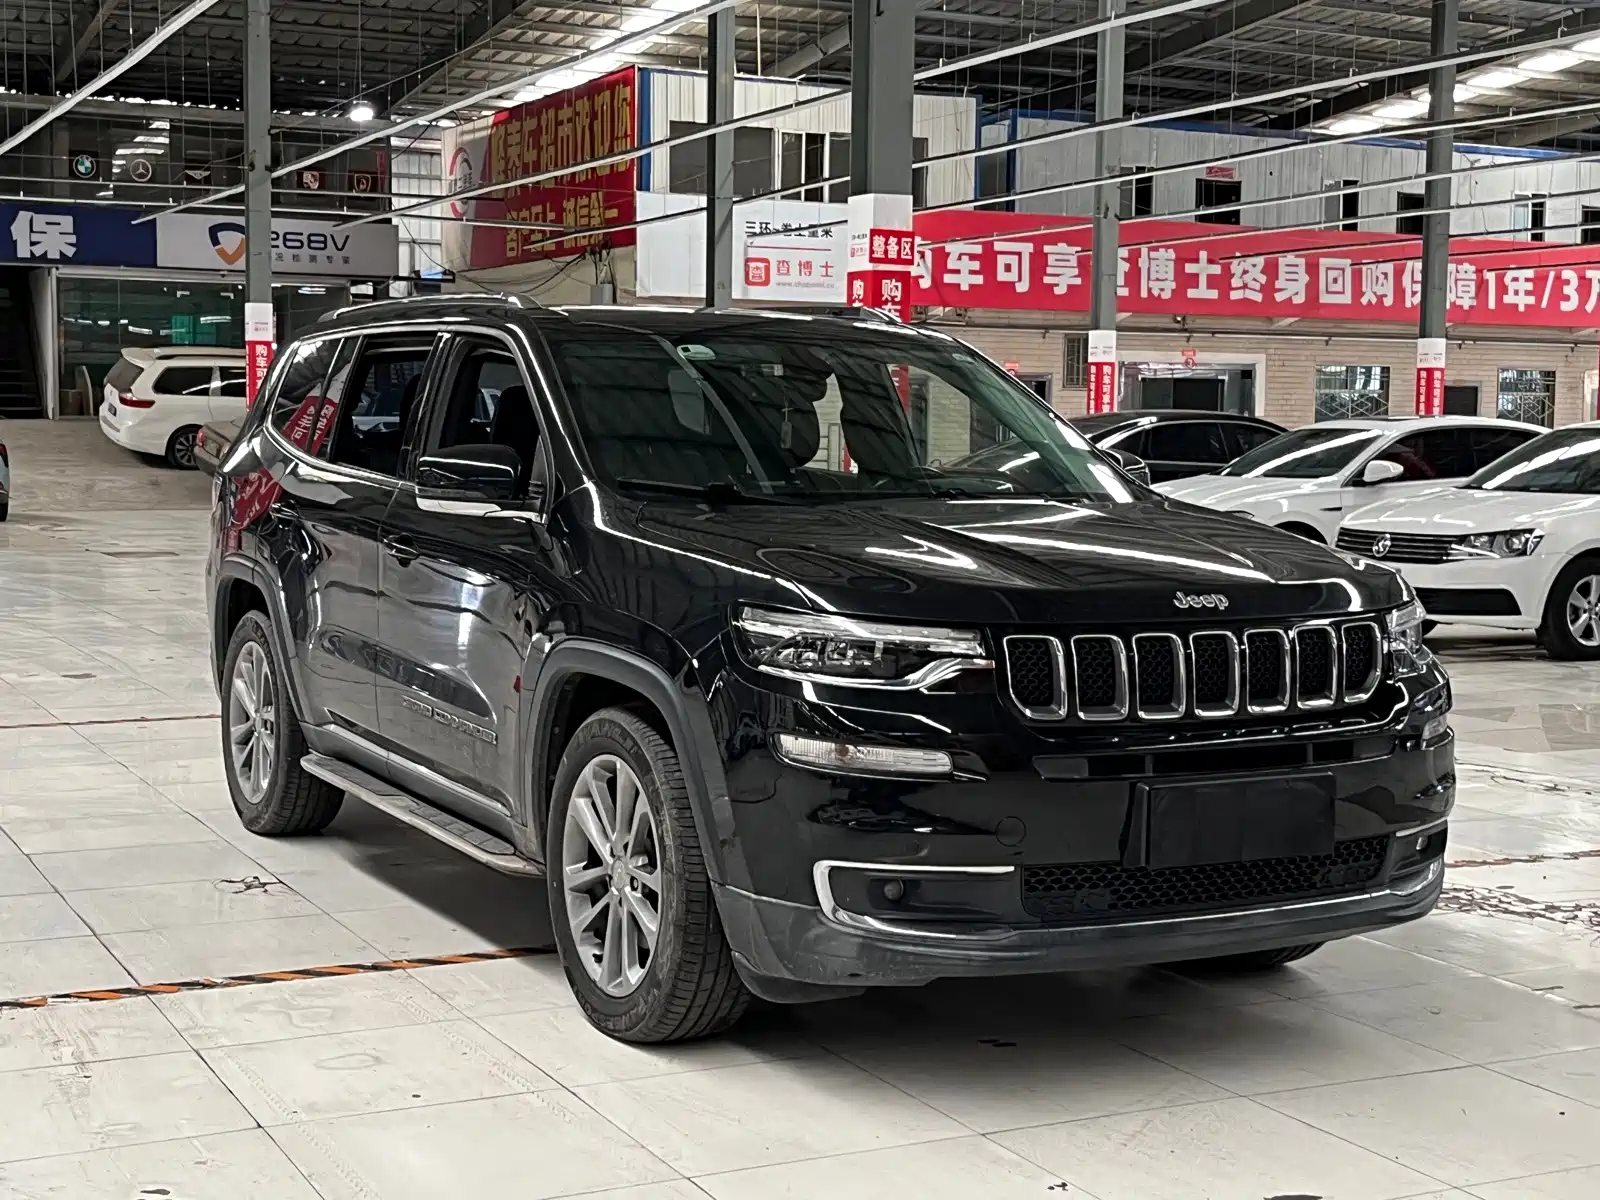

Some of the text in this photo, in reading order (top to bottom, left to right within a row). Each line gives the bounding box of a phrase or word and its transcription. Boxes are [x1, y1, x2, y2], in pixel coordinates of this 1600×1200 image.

[11, 210, 77, 259] 保
[872, 235, 913, 260] 整备区
[1172, 590, 1230, 611] Jeep
